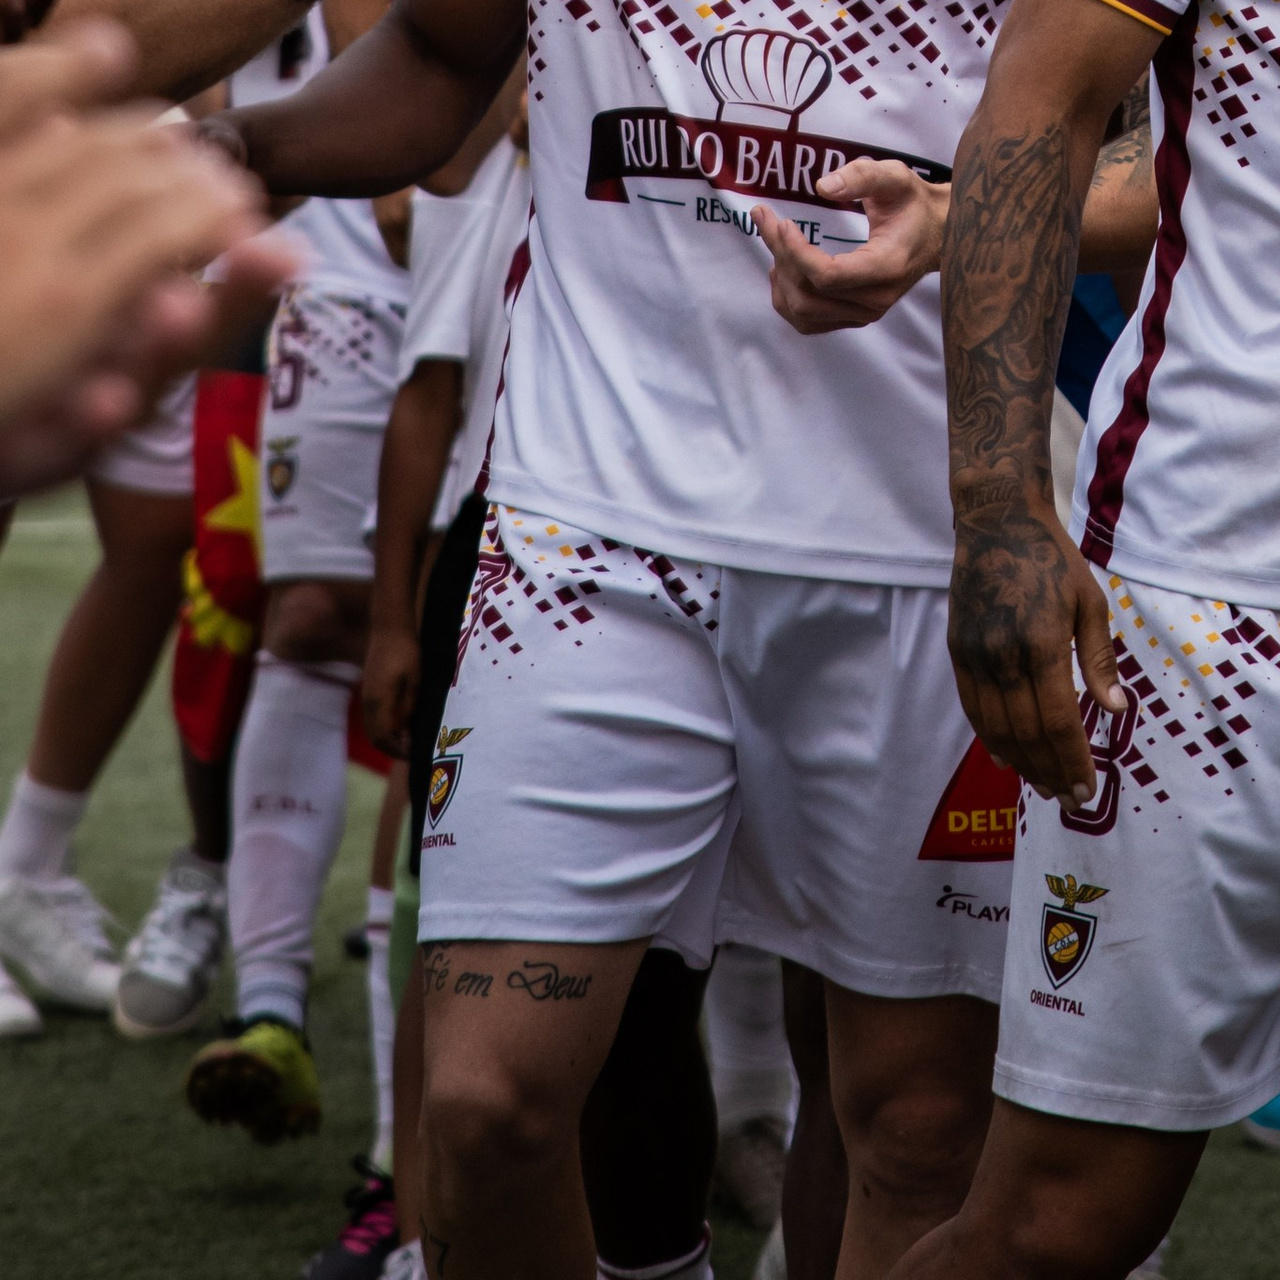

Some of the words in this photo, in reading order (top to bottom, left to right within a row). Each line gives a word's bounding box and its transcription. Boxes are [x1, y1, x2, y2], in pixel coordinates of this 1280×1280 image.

[619, 118, 669, 169] RUI
[675, 125, 724, 180] DO
[948, 806, 1018, 833] DELT
[421, 833, 457, 851] RIENTAL
[951, 900, 1010, 922] PLAY
[454, 971, 494, 998] em
[507, 960, 593, 1001] Deus
[1030, 989, 1085, 1016] ORIENTAL
